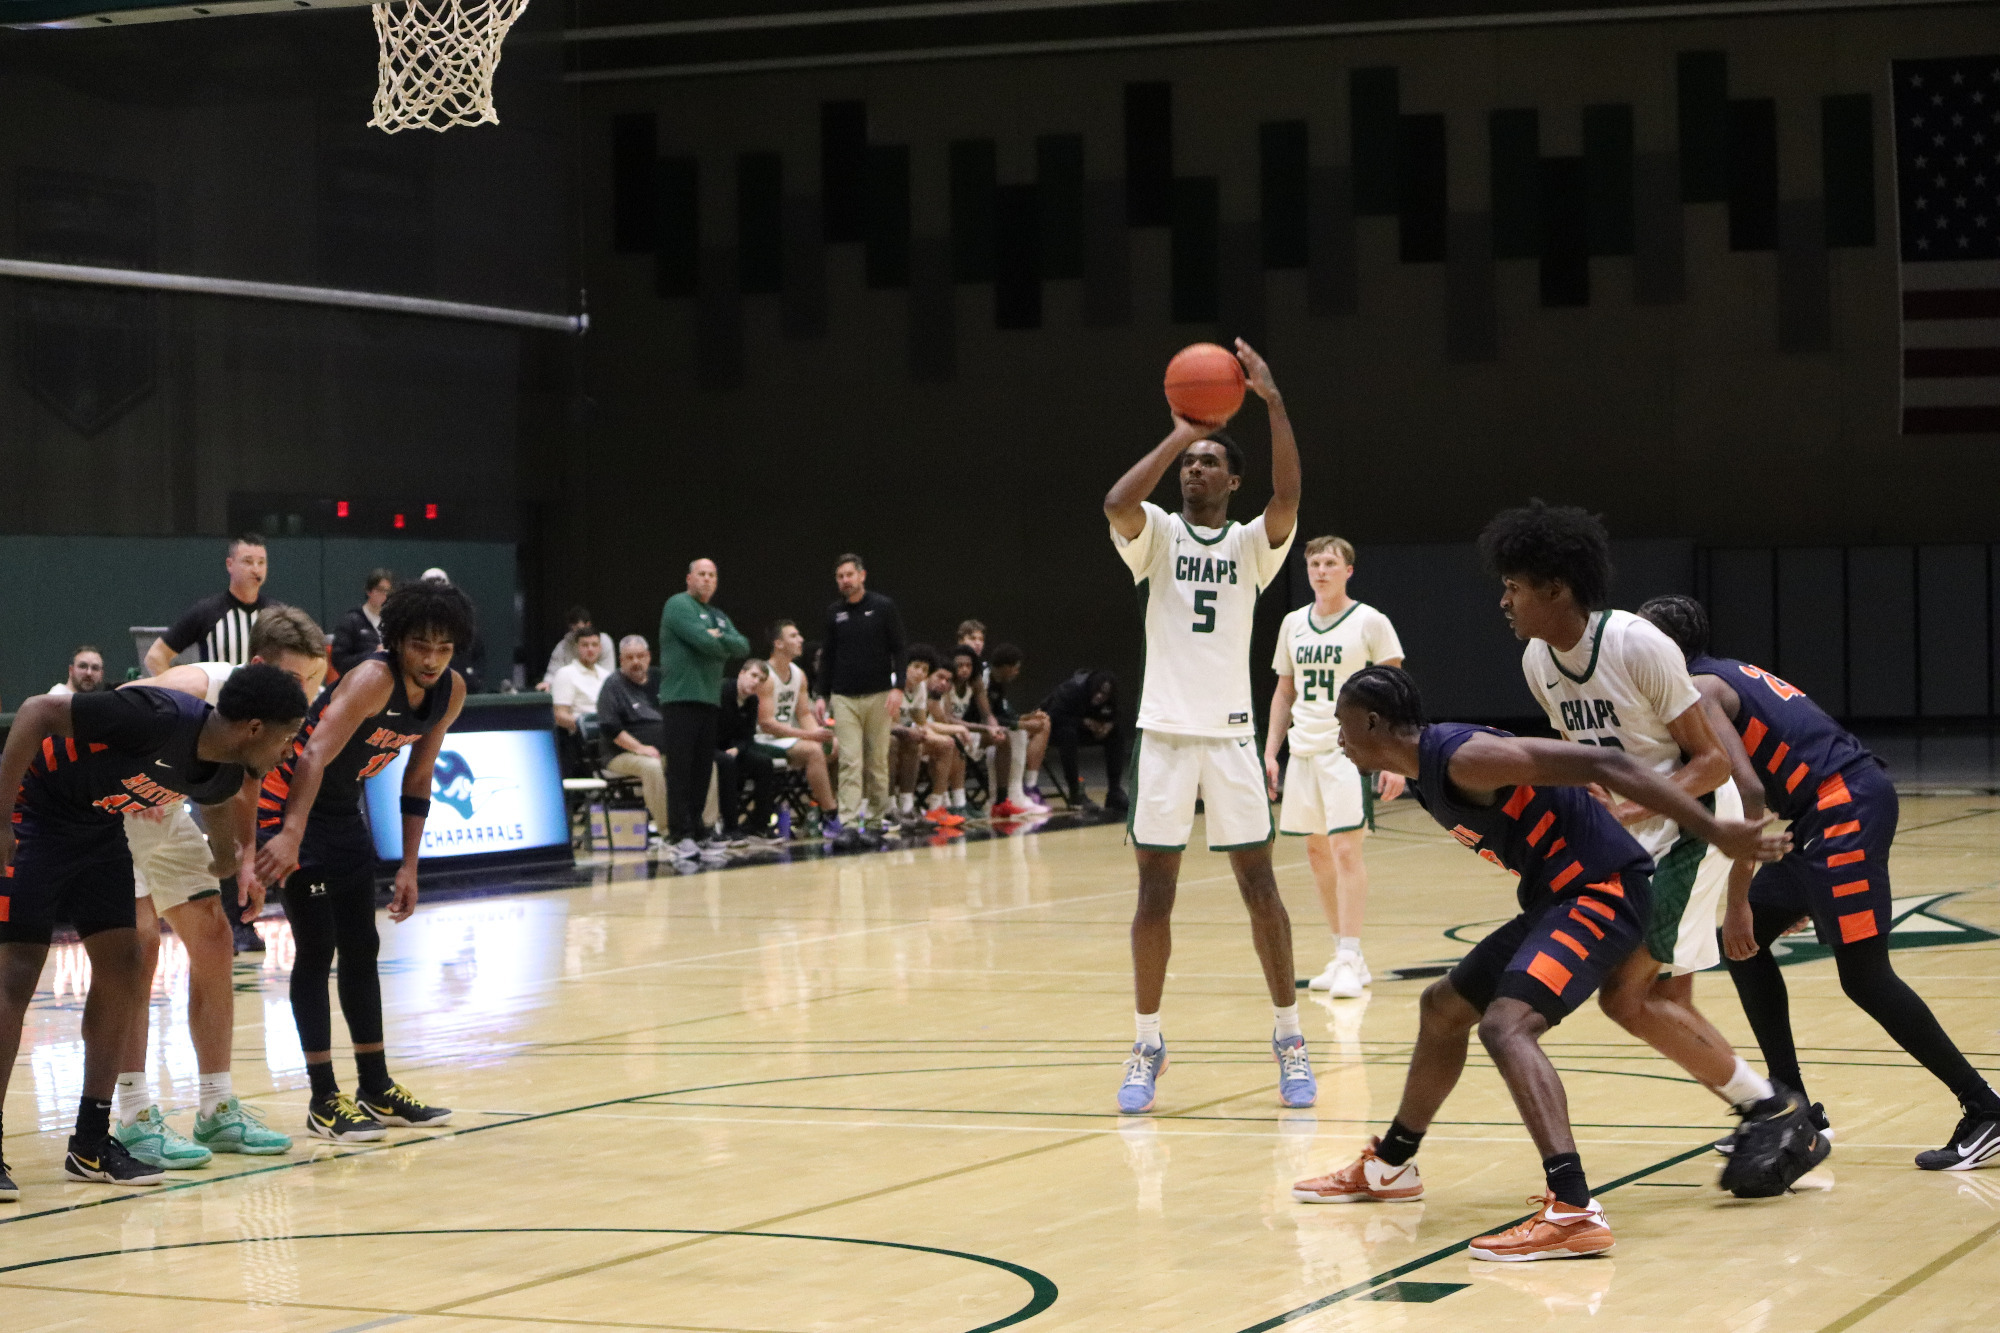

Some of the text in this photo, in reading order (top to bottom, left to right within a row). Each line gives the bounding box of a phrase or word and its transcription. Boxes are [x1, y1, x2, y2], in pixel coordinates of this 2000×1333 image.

[1176, 555, 1237, 585] CHAPS
[1192, 590, 1217, 633] 5
[1296, 645, 1342, 664] CHAPS
[1303, 670, 1334, 701] 24
[1560, 698, 1621, 731] CHAPS
[424, 824, 524, 848] CHAPARRALS
